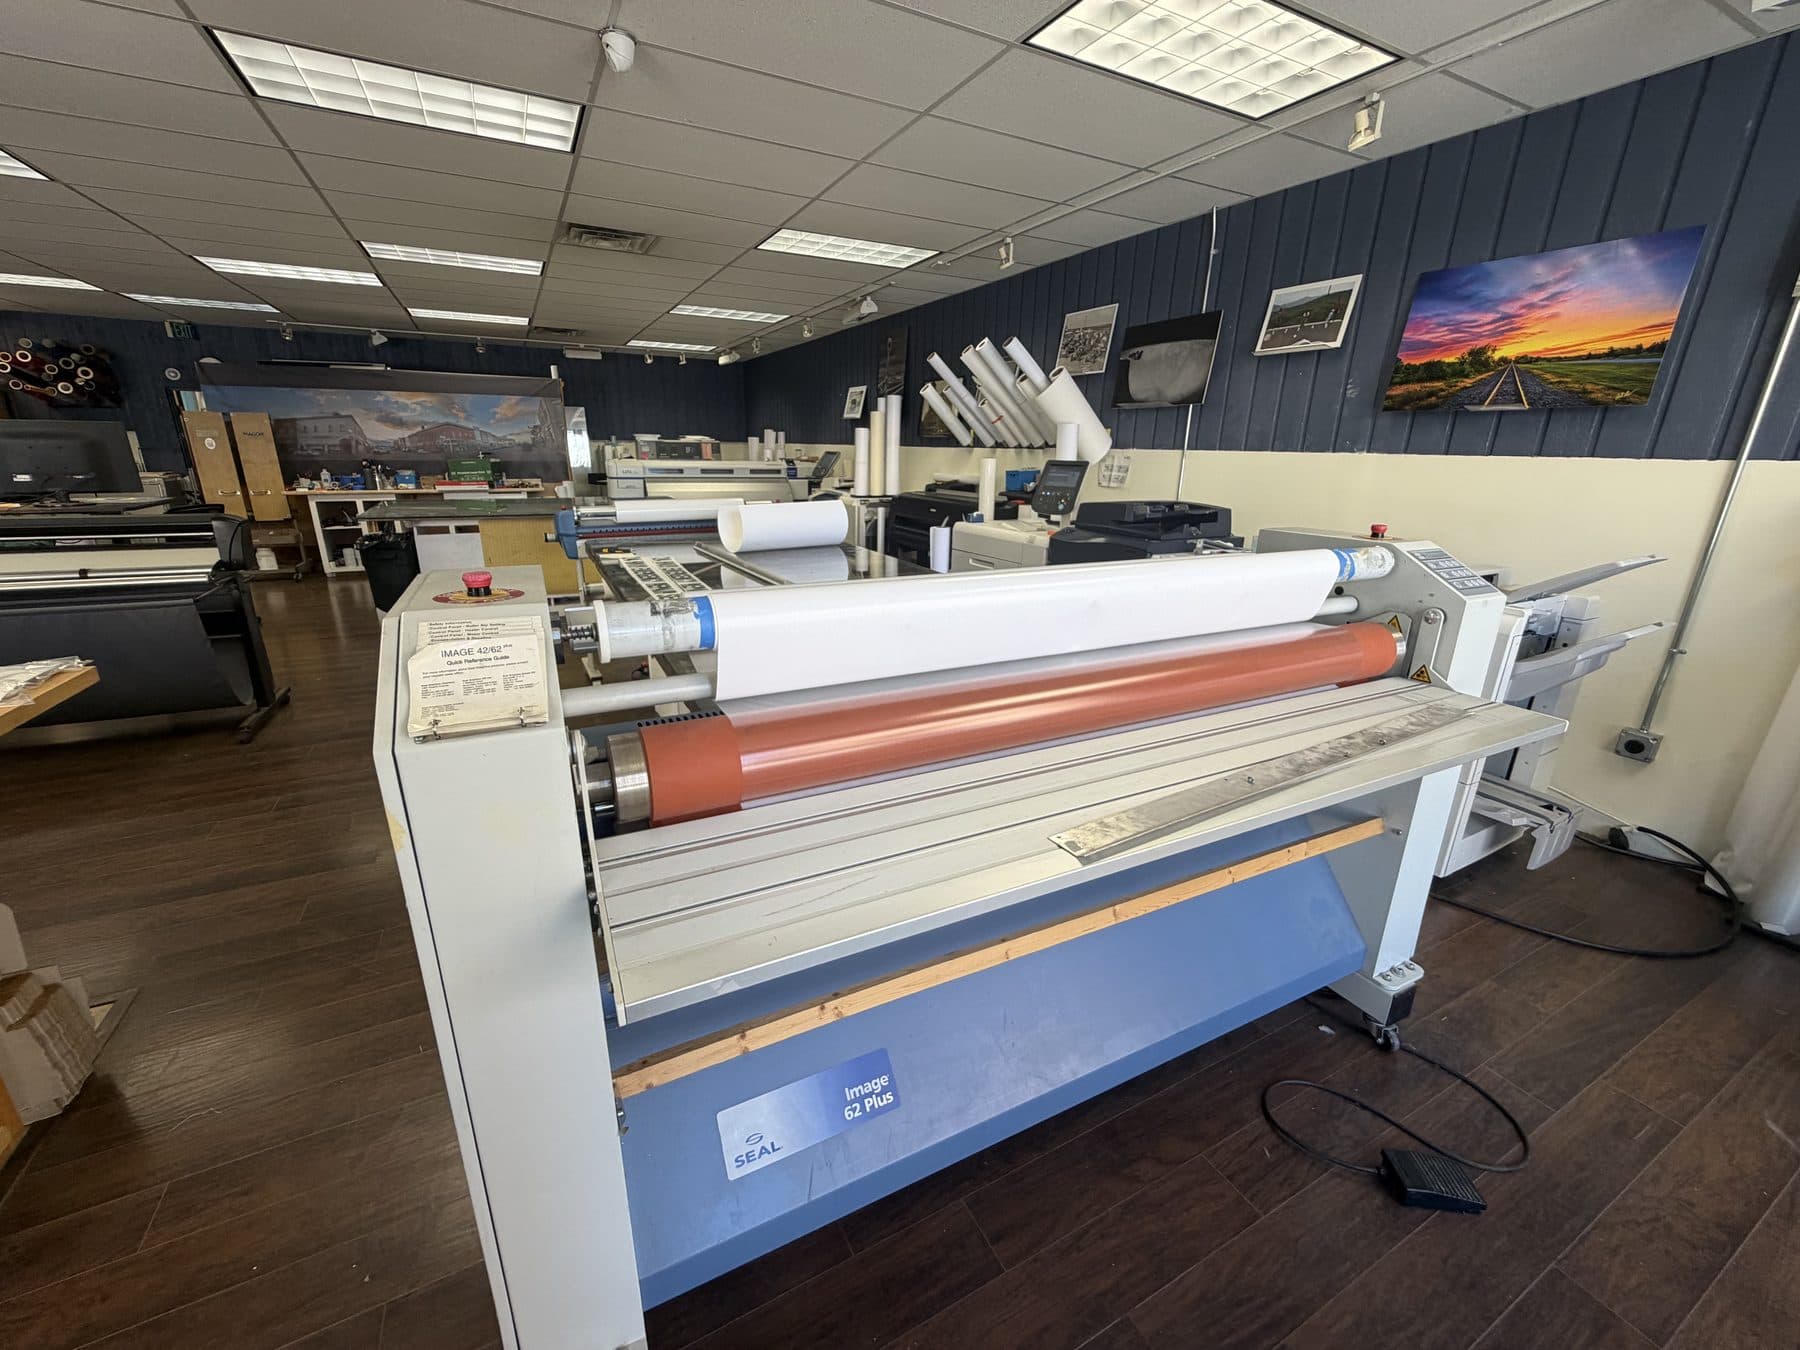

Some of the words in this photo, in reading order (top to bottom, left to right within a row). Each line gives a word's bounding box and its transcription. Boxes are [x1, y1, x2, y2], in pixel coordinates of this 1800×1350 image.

[173, 323, 193, 338] EXIT
[441, 648, 474, 659] IMAGE
[477, 645, 502, 654] 42/62
[464, 656, 492, 664] Reference
[844, 1073, 889, 1101] Image
[843, 1102, 863, 1121] 62
[864, 1090, 894, 1113] Plus
[733, 1141, 783, 1169] SEAL
